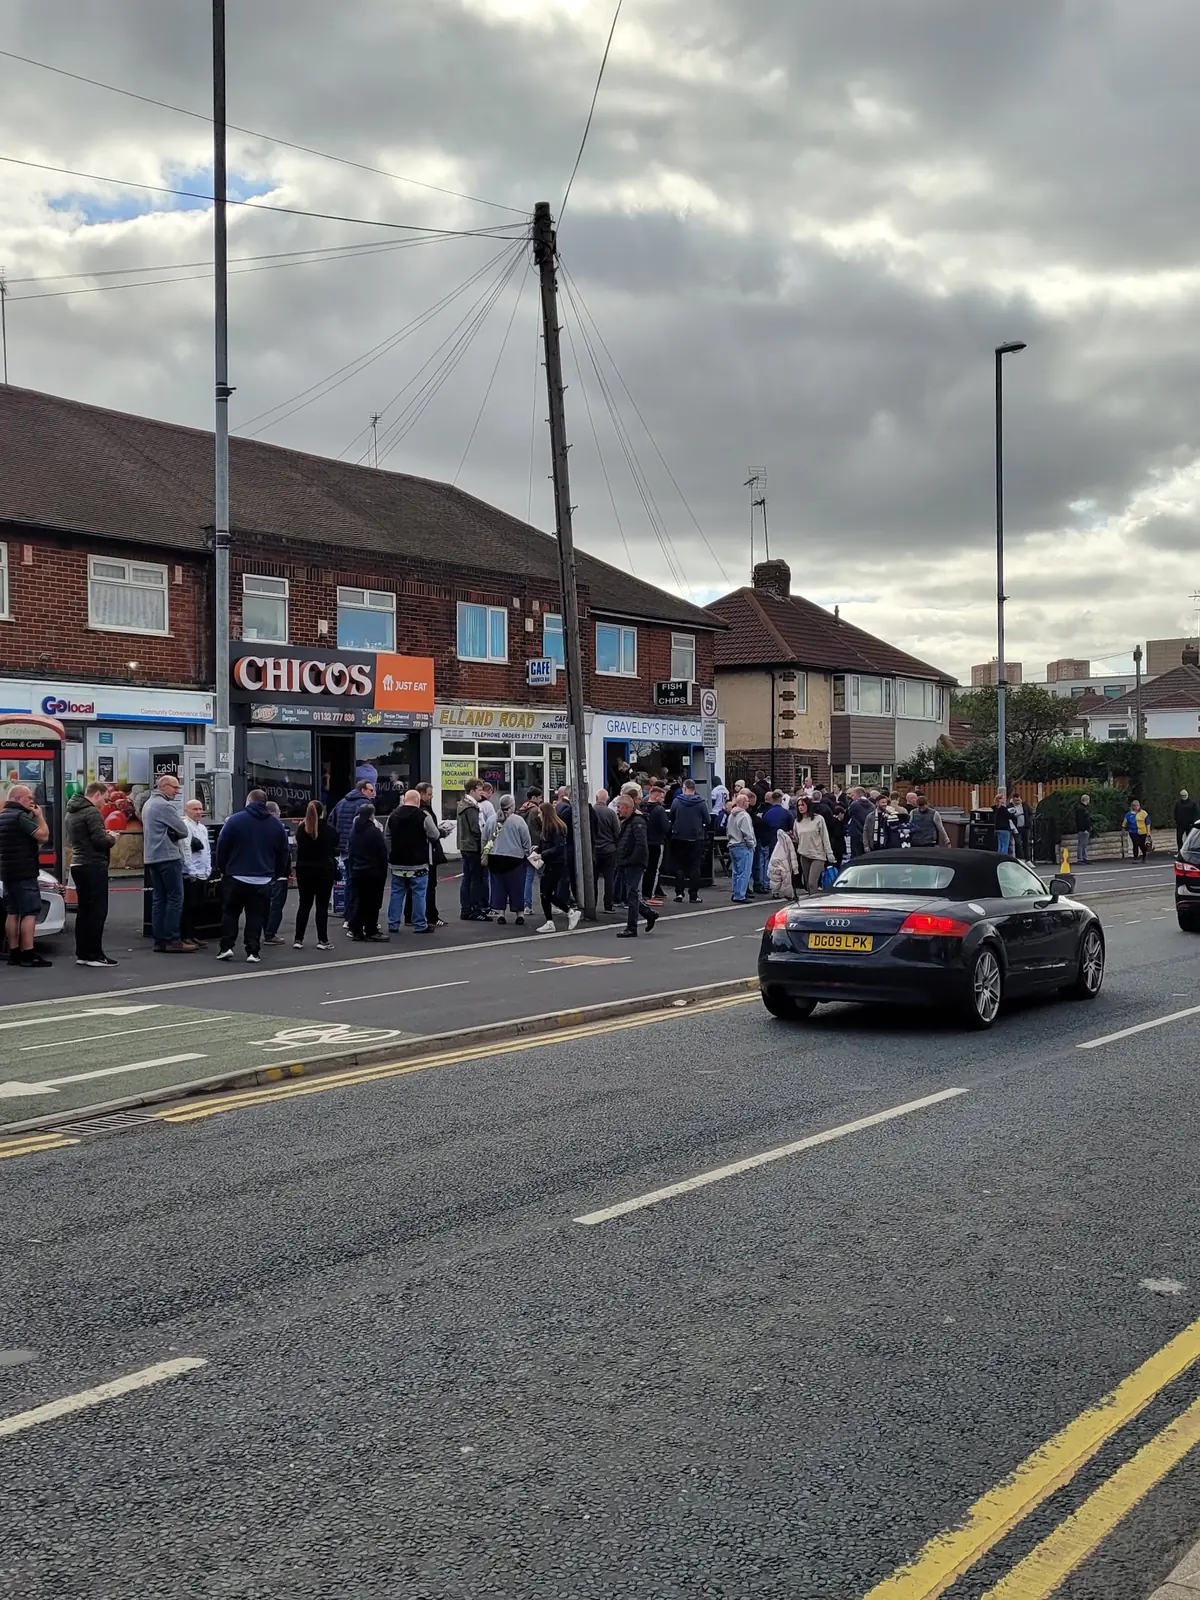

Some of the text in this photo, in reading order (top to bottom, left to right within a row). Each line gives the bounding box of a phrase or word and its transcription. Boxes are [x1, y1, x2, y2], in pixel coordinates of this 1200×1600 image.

[531, 661, 550, 675] CAFE
[235, 656, 372, 696] CHICOS
[395, 680, 427, 691] JUST EAT
[662, 682, 682, 690] FISH
[658, 696, 686, 704] CHIPS
[140, 708, 168, 716] Community
[168, 709, 198, 717] Convenience
[313, 711, 332, 720] 01132
[332, 713, 343, 721] 777
[440, 709, 535, 728] ELLAND ROAD
[607, 720, 660, 735] GRAVELEY'S
[662, 723, 679, 736] FISH
[682, 724, 688, 736] &
[156, 760, 176, 772] cash
[814, 936, 868, 948] DG09 LPK
